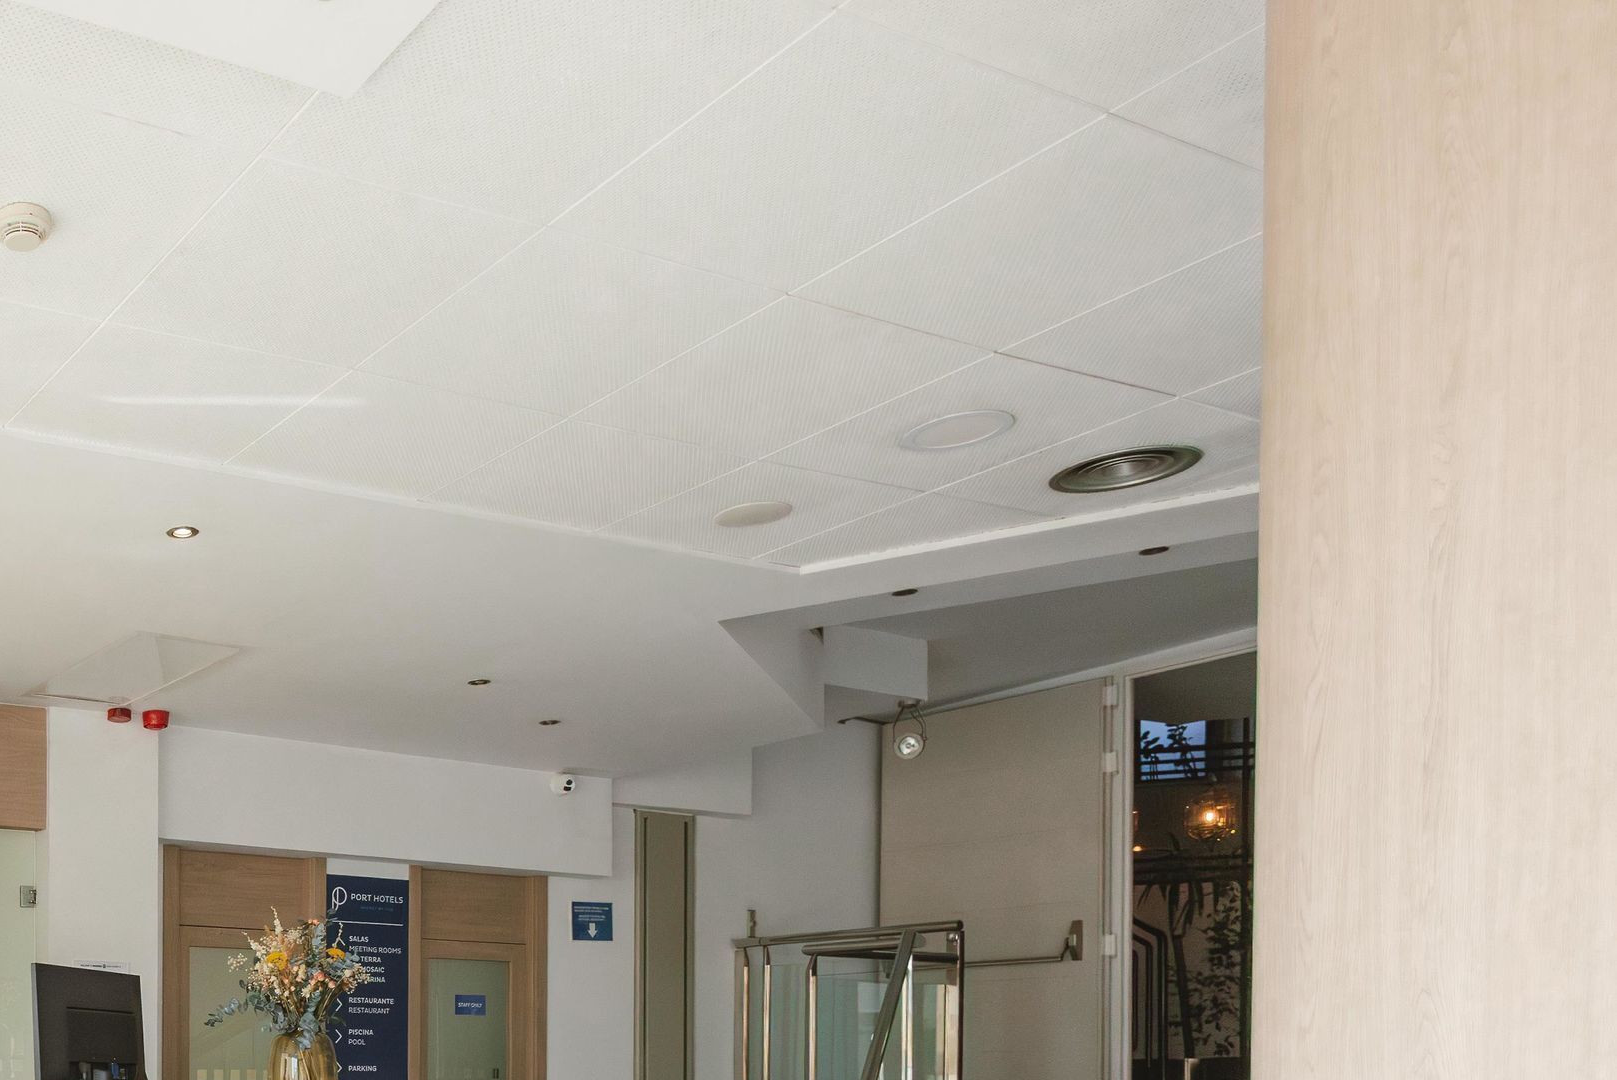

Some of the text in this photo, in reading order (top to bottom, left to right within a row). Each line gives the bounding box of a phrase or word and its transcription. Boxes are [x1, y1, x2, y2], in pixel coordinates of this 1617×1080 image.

[350, 893, 404, 904] PORT HOTELS
[349, 935, 369, 943] SALAS
[349, 945, 402, 955] MEETING ROOMS
[360, 955, 382, 963] TERRA
[348, 997, 395, 1005] RESTAURANTE
[348, 1006, 391, 1014] RESTAURANT
[348, 1028, 374, 1036] PISCINA
[348, 1038, 366, 1046] POOL
